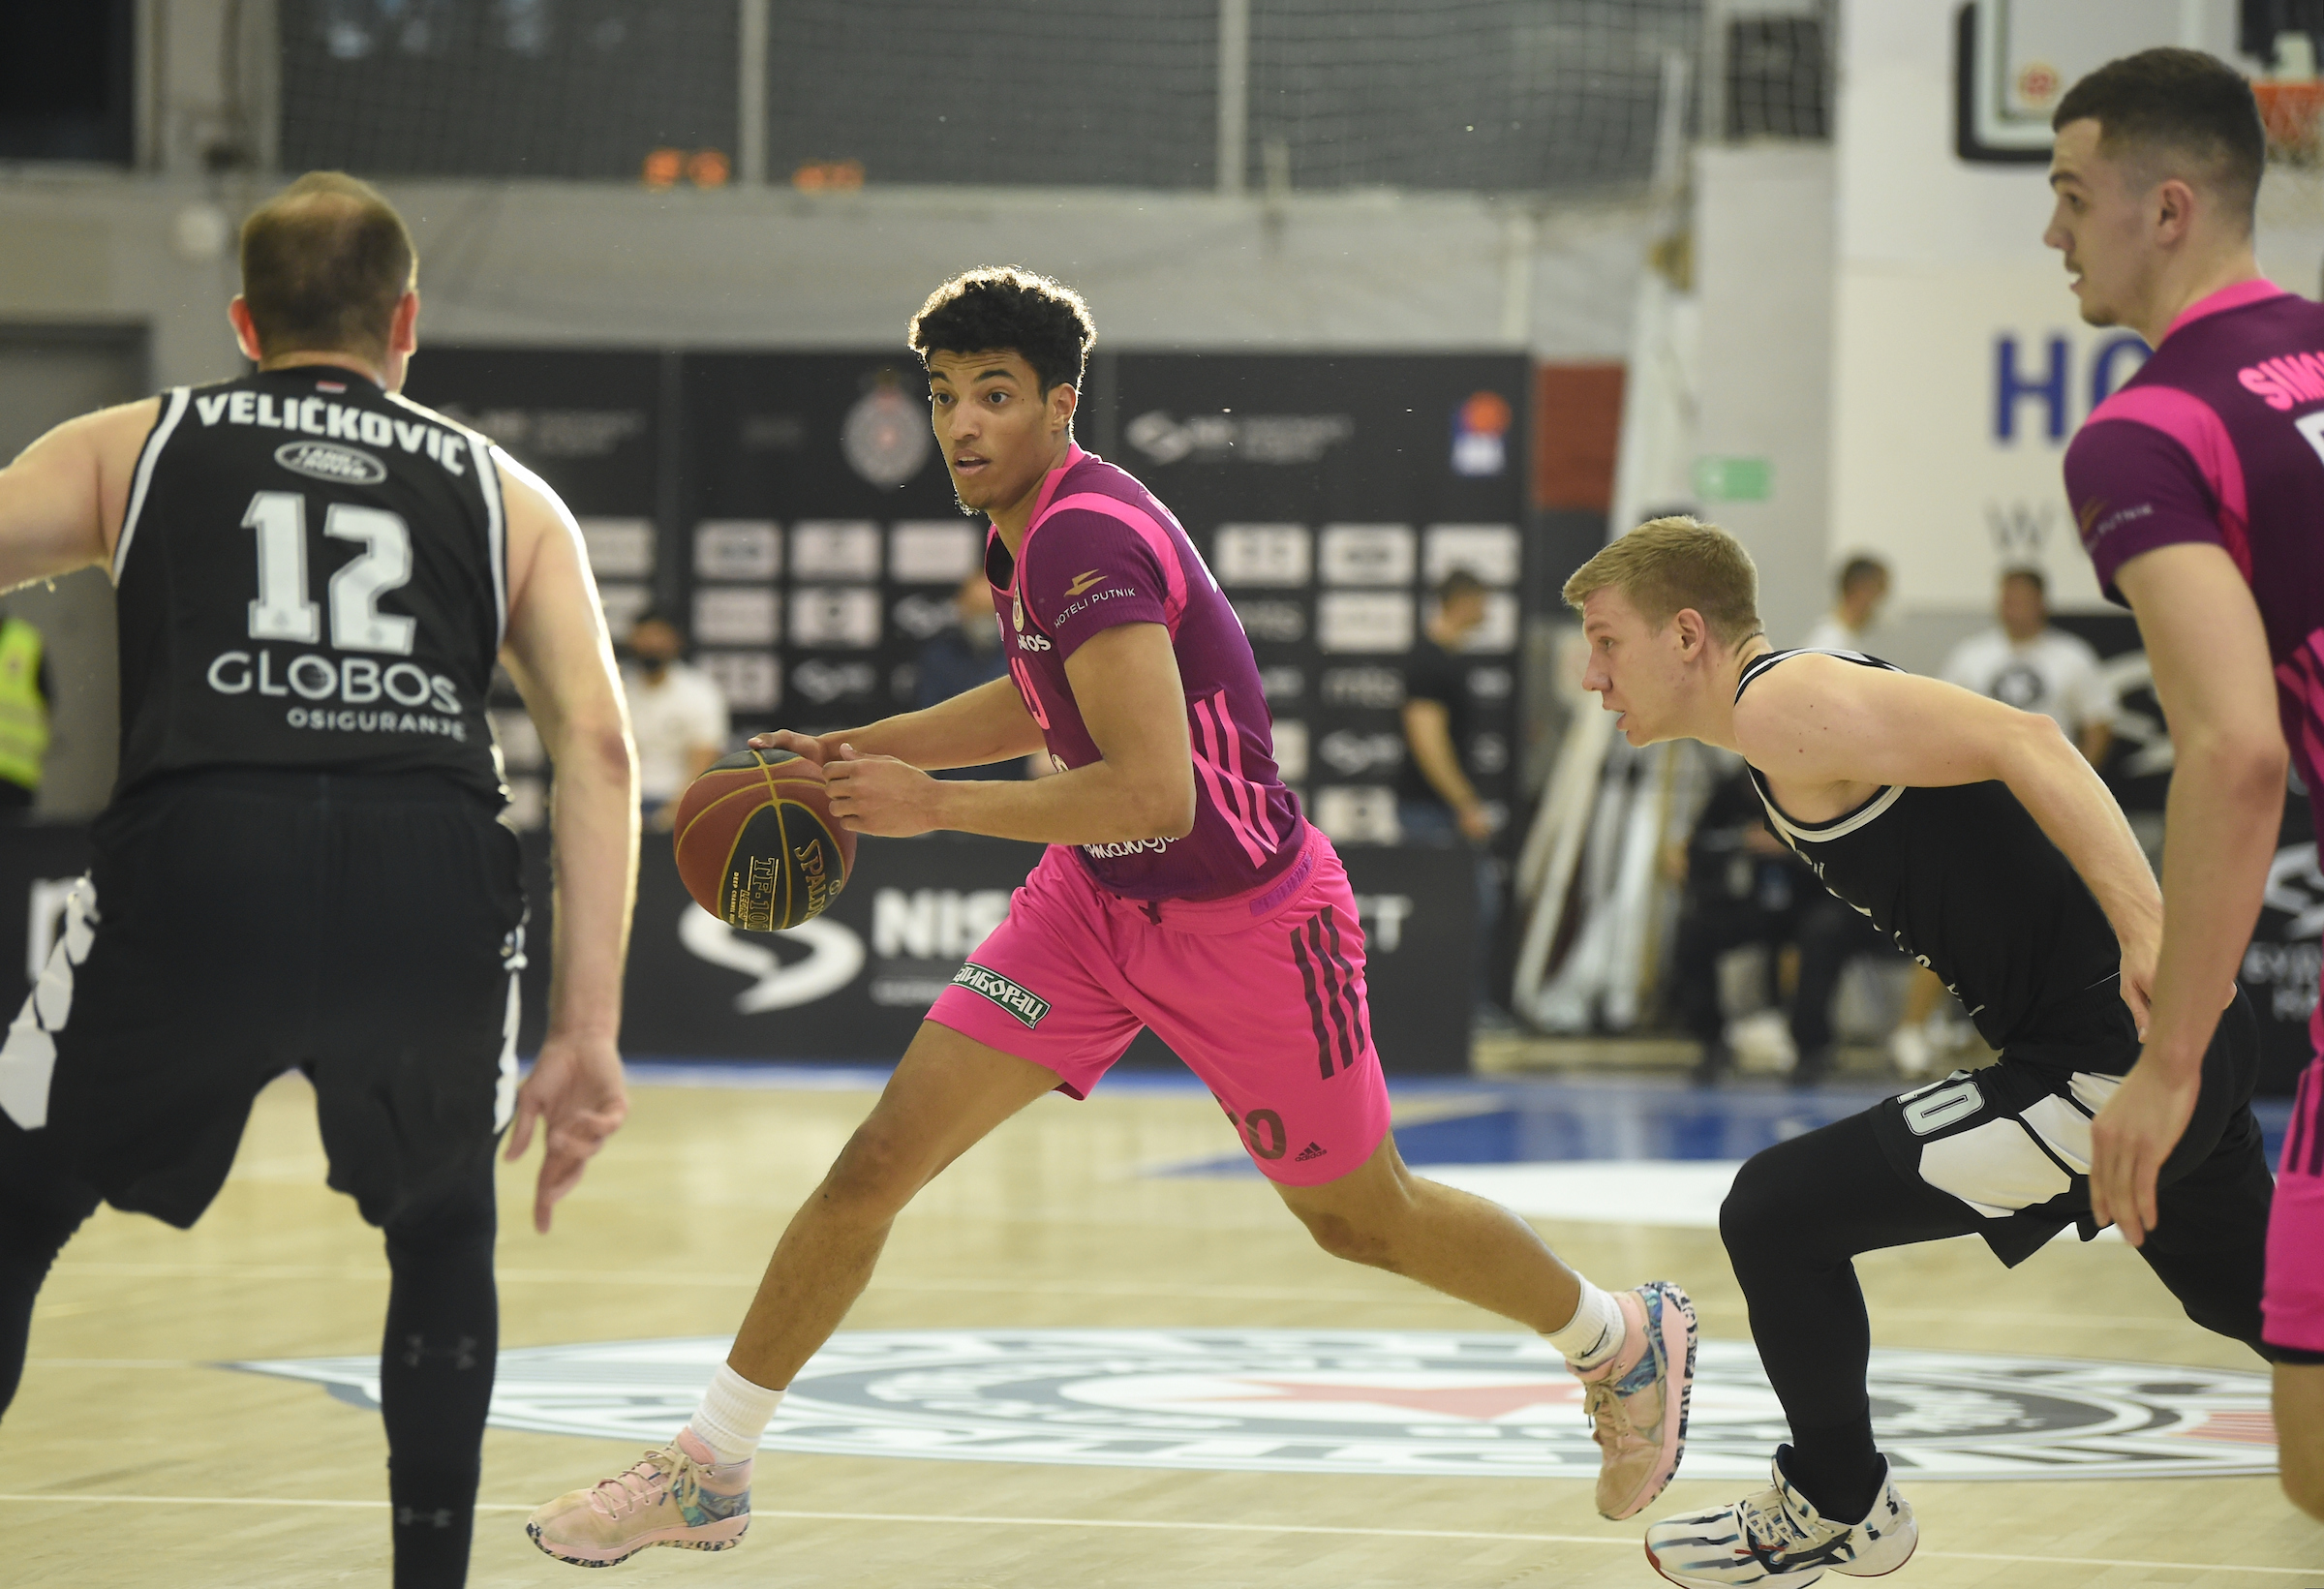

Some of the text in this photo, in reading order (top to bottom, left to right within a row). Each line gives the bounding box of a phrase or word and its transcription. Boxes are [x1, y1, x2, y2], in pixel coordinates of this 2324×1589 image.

[240, 490, 416, 656] 12
[1054, 588, 1136, 628] HOTELI PUTNIK
[207, 649, 462, 714] GLOBOS
[287, 707, 466, 743] OSIGURANJE
[1295, 1149, 1328, 1162] adidas
